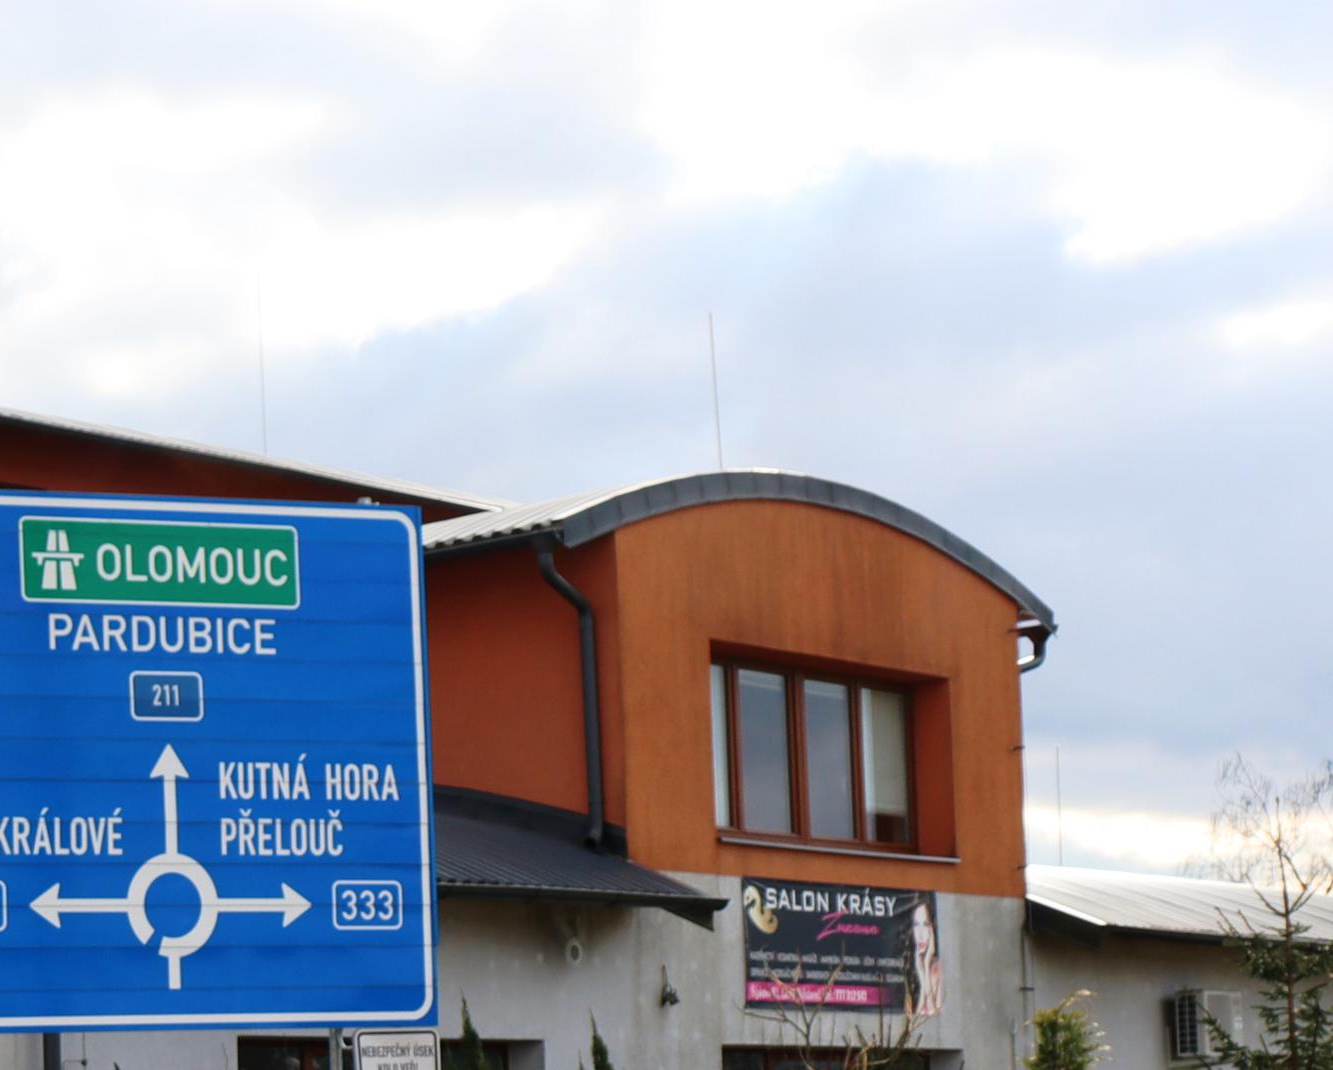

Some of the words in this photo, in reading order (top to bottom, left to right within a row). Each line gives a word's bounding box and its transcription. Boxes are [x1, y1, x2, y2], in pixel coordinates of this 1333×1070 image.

[96, 543, 288, 587] OLOMOUC
[47, 612, 277, 655] PARDUBICE
[151, 684, 180, 706] 211
[218, 754, 310, 800] KUTNÁ
[325, 763, 399, 801] HORA
[220, 808, 344, 857] PŘELOUČ
[341, 890, 394, 921] 333
[765, 887, 830, 912] SALON
[836, 888, 897, 917] KRÁSY
[361, 1042, 411, 1057] NEBEZPEČNÝ
